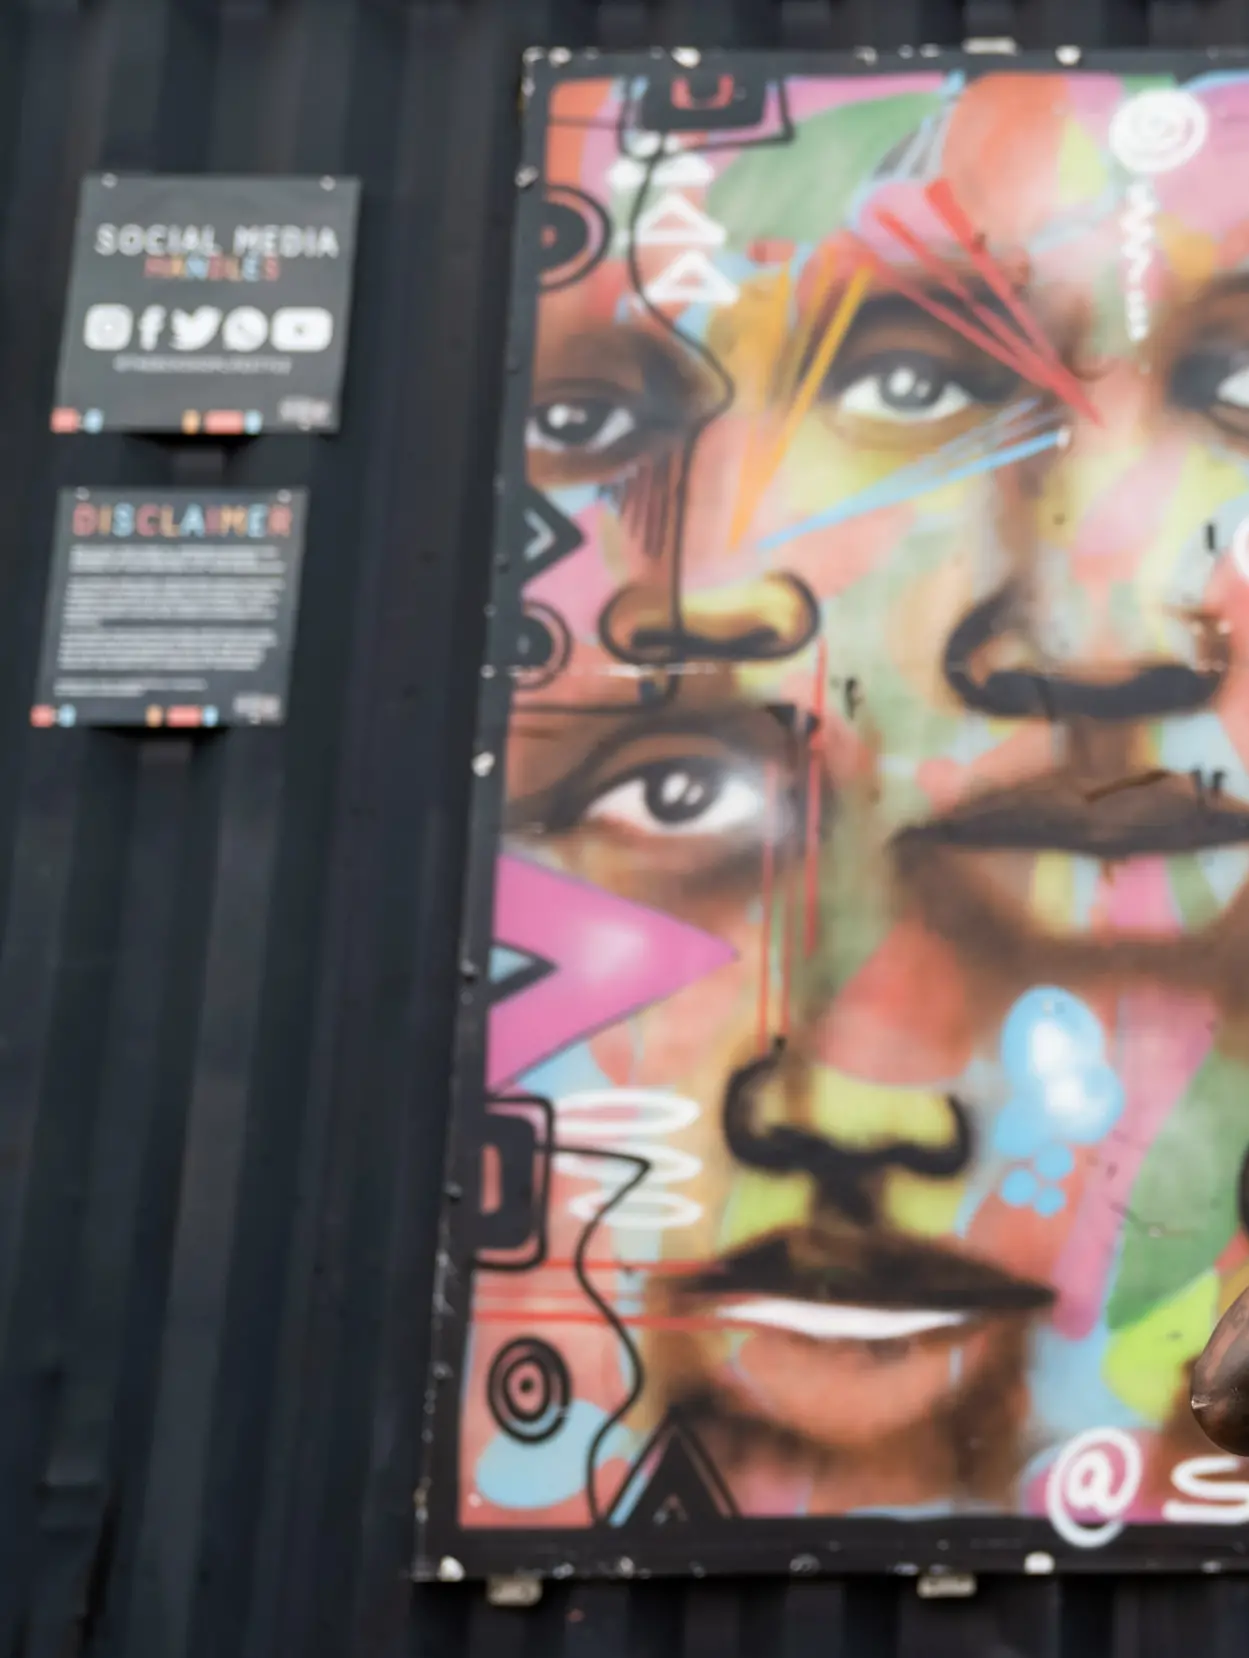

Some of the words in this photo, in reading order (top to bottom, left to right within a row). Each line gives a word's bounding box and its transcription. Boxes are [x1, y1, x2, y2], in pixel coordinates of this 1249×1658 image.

[94, 223, 221, 256] SOCIAL
[233, 224, 339, 258] MEDIA
[71, 502, 293, 537] DISCLAIMER
